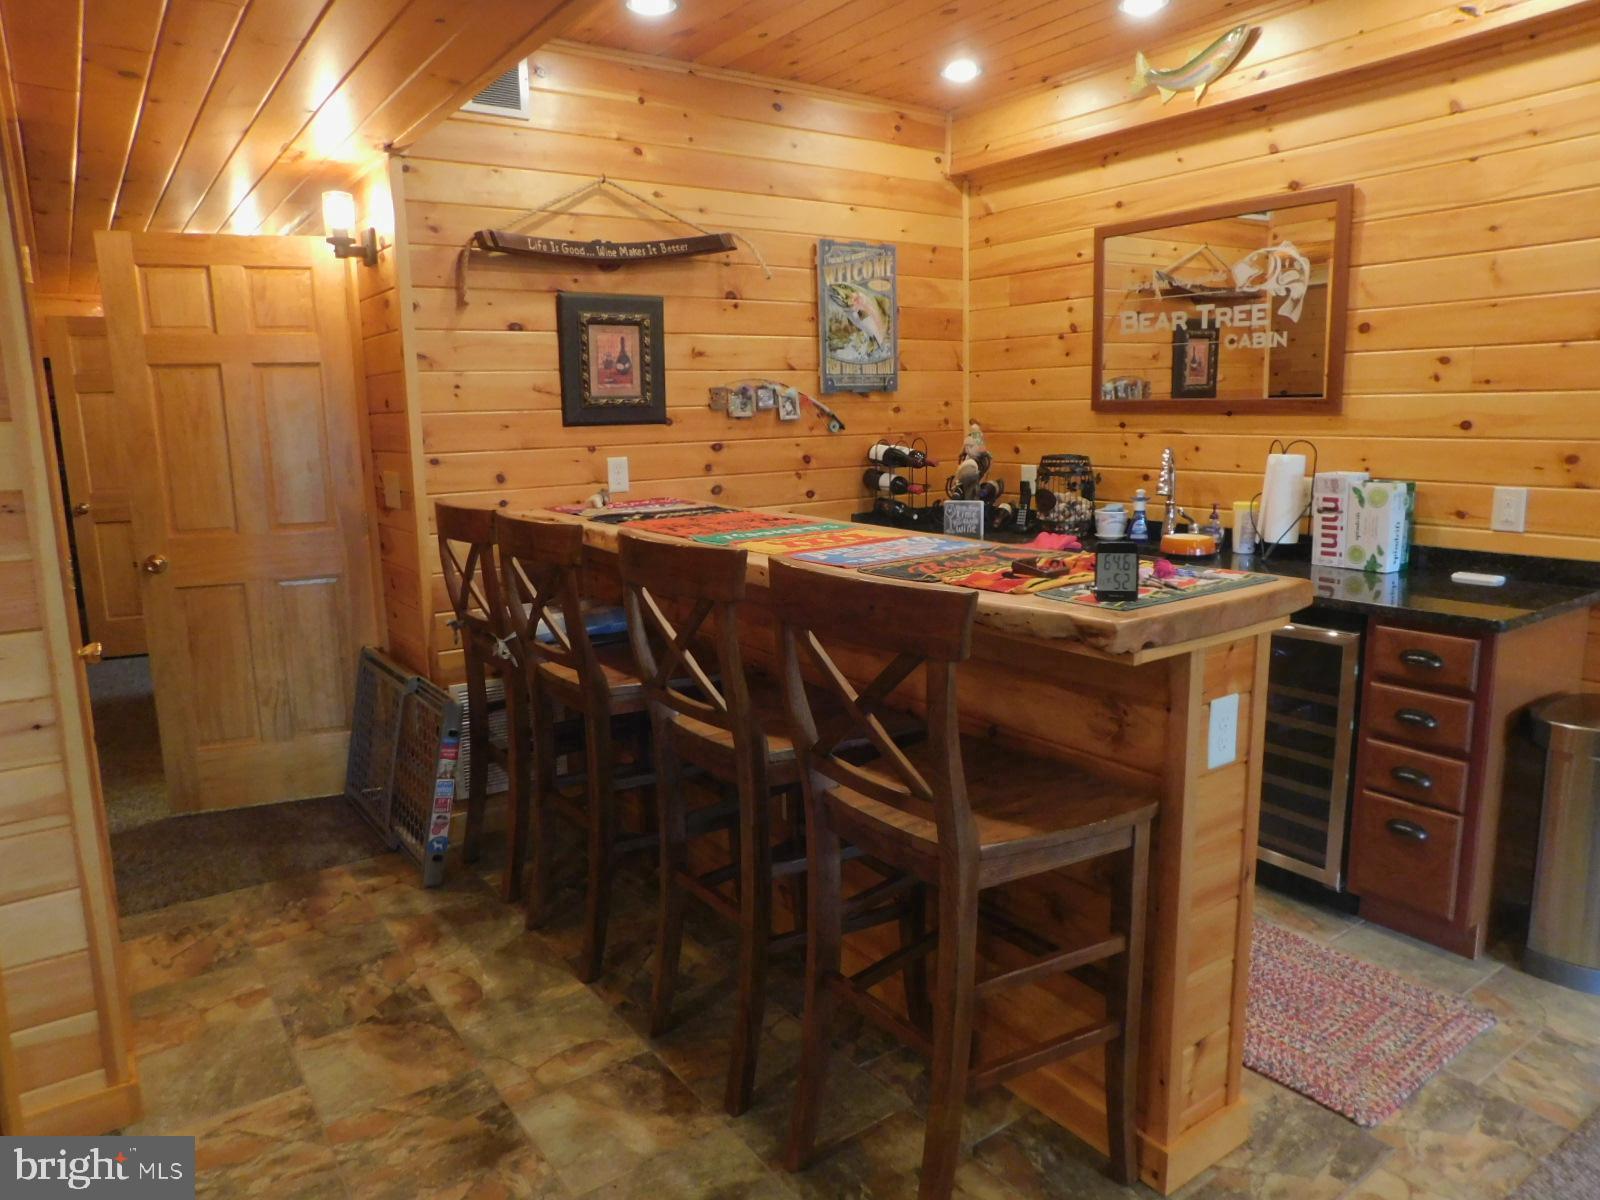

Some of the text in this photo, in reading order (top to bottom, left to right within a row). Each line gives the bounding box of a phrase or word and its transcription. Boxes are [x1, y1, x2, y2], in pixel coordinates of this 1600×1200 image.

[528, 238, 547, 252] Life
[550, 240, 560, 253] Is
[596, 244, 617, 257] Wine
[619, 244, 646, 256] Makes
[647, 243, 658, 255] It
[660, 241, 689, 254] Better
[1119, 303, 1269, 335] BEAR TREE
[1225, 331, 1288, 350] CABIN
[1320, 497, 1343, 557] mini
[1113, 573, 1130, 589] 52
